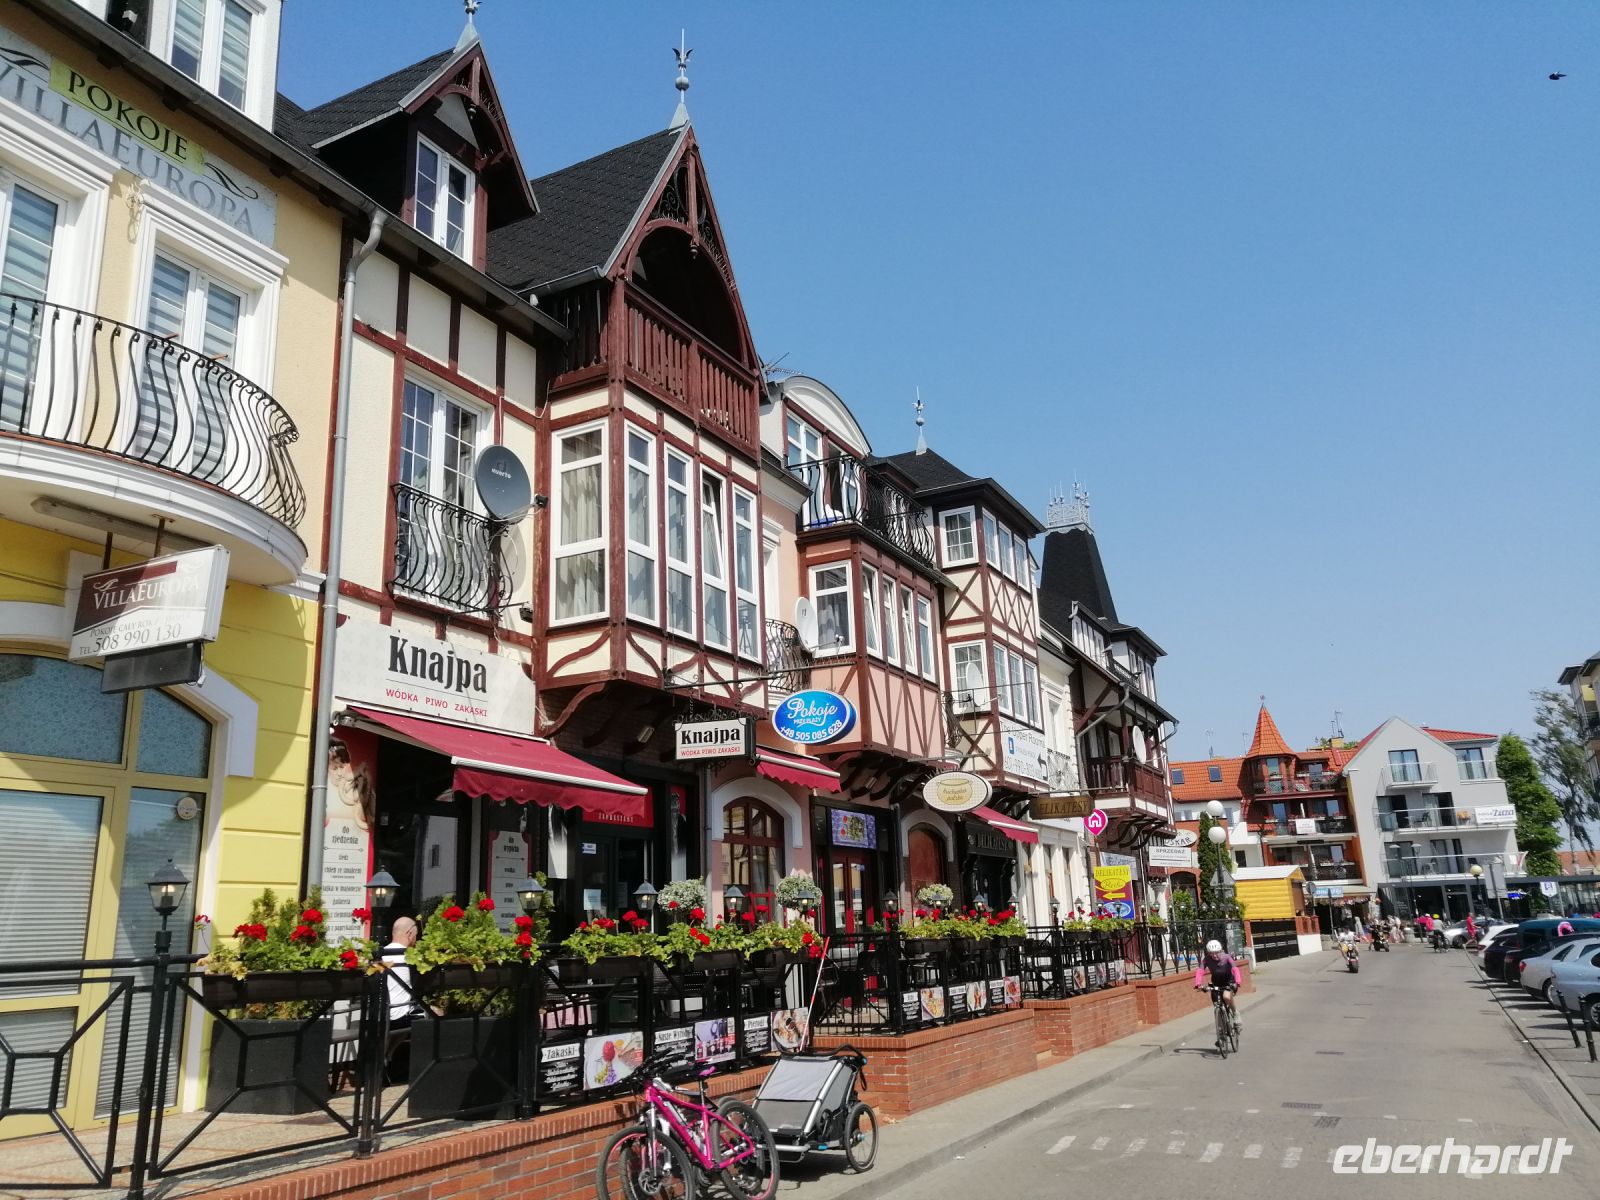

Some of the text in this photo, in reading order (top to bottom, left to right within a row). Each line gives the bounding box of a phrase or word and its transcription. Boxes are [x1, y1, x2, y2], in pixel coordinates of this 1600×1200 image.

[68, 69, 188, 160] POKOJE
[93, 634, 119, 653] 508
[124, 628, 150, 648] 990
[156, 623, 181, 641] 130
[388, 635, 487, 693] Knajpa
[385, 688, 419, 703] WÓDKA
[425, 697, 448, 709] PIWO
[787, 698, 838, 726] Pokoje
[681, 727, 741, 745] Knajpa
[780, 719, 843, 741] +48 505 085 628
